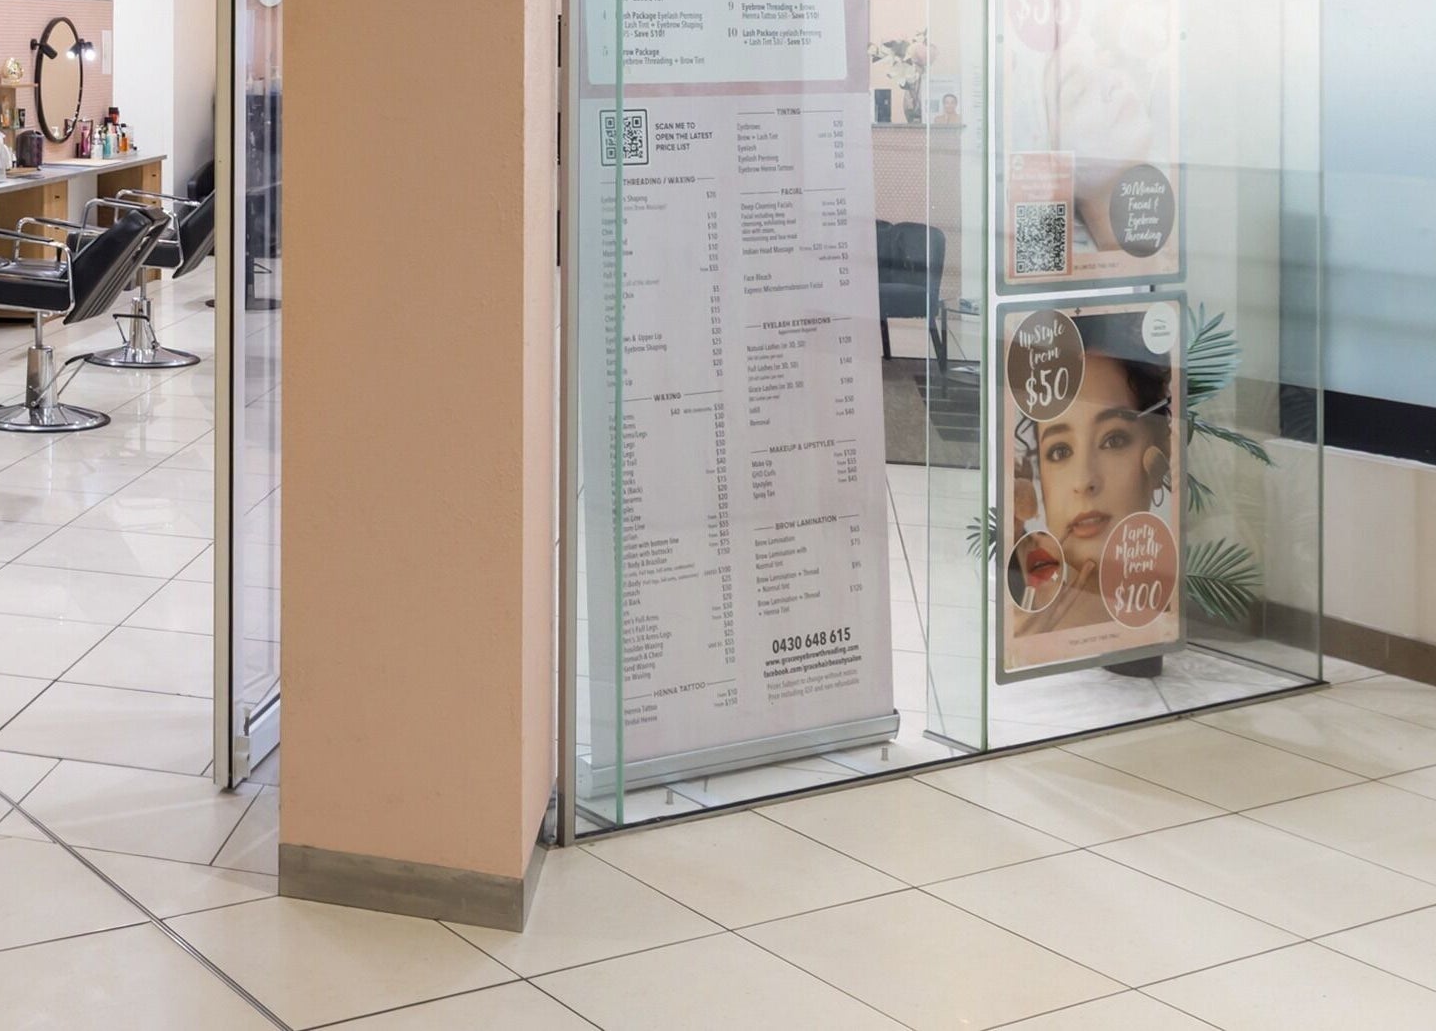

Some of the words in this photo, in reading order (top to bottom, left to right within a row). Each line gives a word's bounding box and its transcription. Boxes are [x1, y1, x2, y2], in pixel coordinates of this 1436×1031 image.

[633, 12, 656, 22] Package
[727, 27, 738, 38] 10
[635, 48, 659, 57] Package
[655, 122, 675, 131] SCAN
[676, 122, 684, 130] ME
[686, 122, 696, 130] TO
[655, 133, 674, 141] OPEN
[690, 132, 713, 140] LATEST
[677, 143, 690, 151] LIST
[668, 176, 696, 185] WAXING
[1132, 181, 1166, 195] Minutes
[1128, 197, 1151, 211] Facial
[1127, 213, 1159, 228] Eyebrow
[1124, 228, 1163, 247] Threading
[1029, 347, 1062, 370] from
[1025, 367, 1069, 413] $50
[775, 521, 795, 530] BROW
[796, 515, 837, 527] LAMINATION
[1124, 559, 1154, 579] from
[1114, 580, 1162, 617] $100
[772, 635, 802, 654] 0430
[805, 631, 827, 649] 648
[829, 626, 851, 644] 615
[653, 687, 678, 698] HENNA
[679, 681, 706, 693] TATTOO
